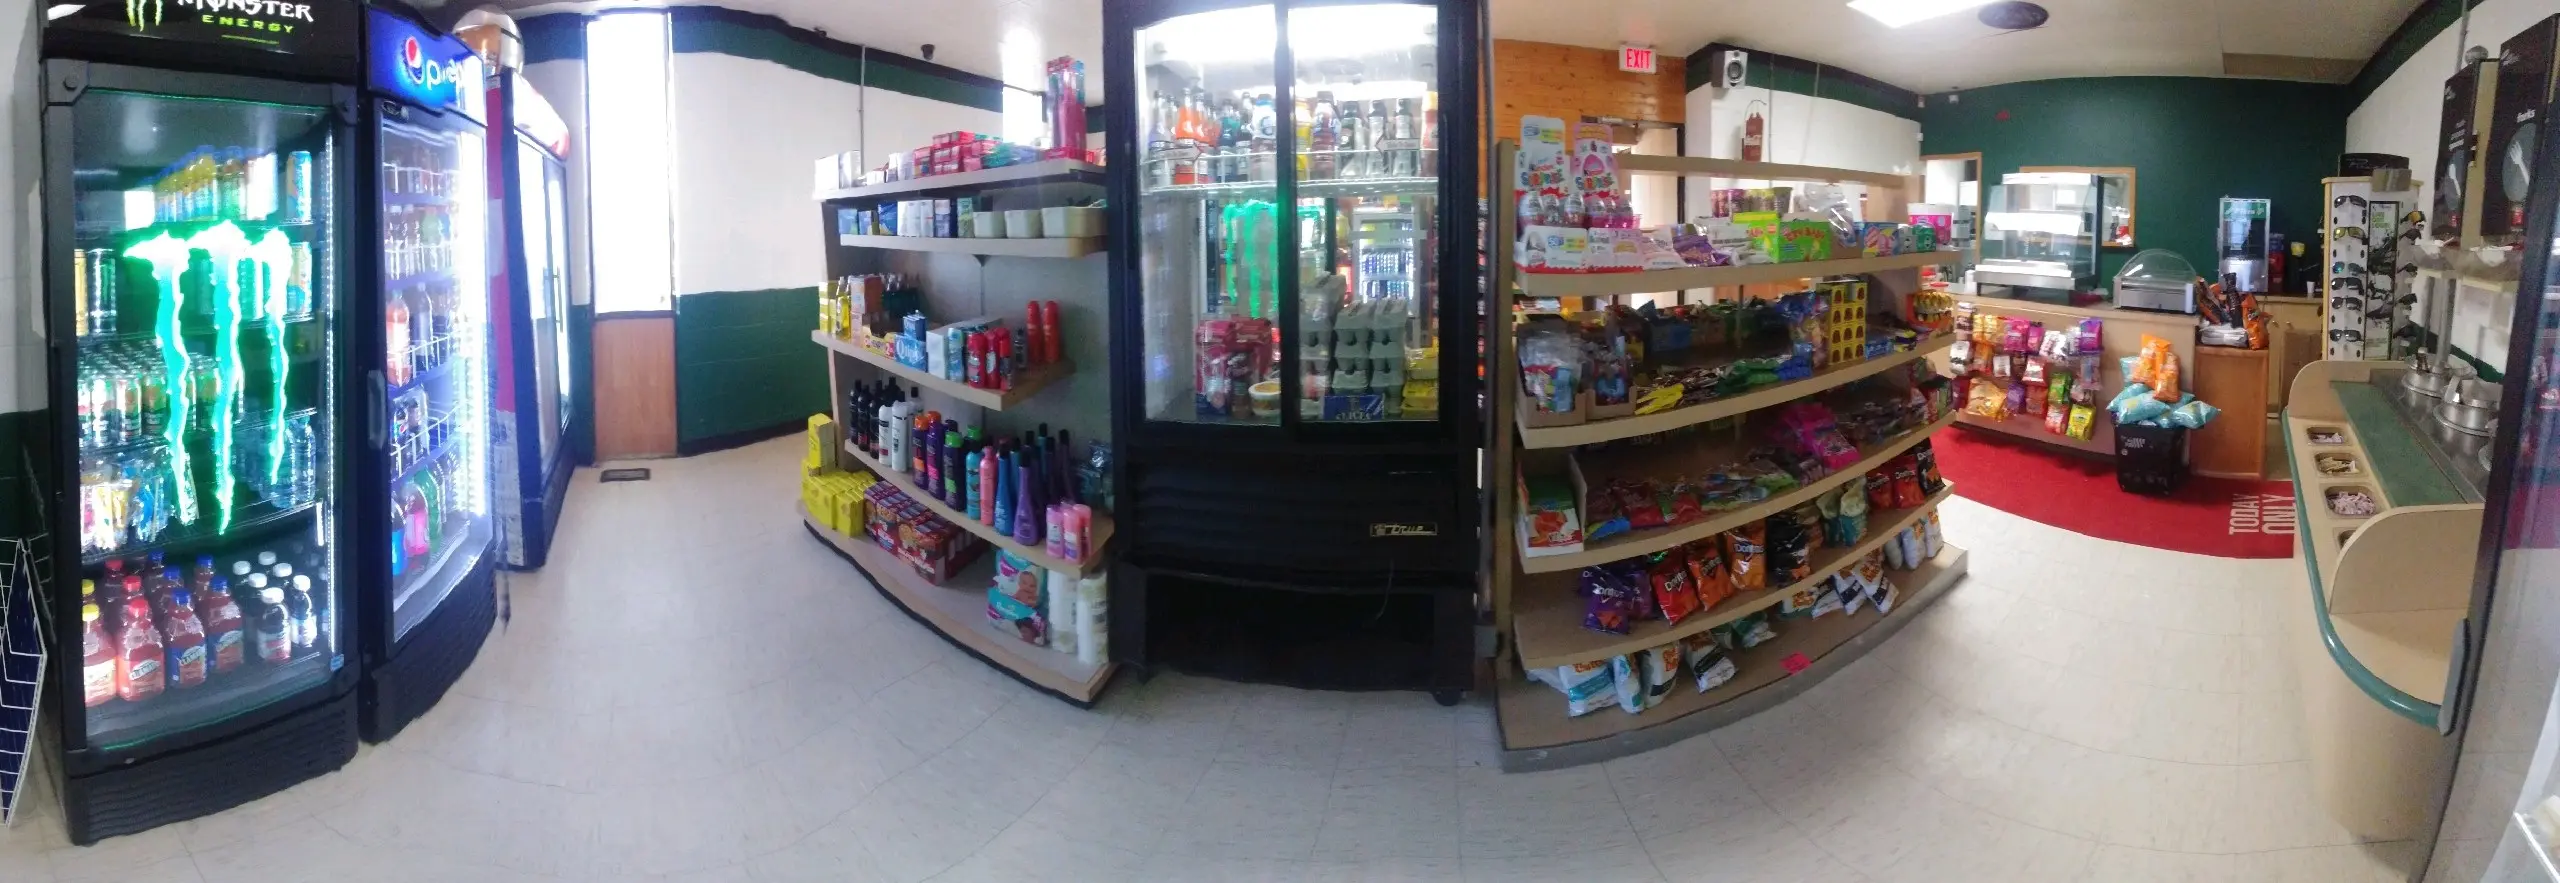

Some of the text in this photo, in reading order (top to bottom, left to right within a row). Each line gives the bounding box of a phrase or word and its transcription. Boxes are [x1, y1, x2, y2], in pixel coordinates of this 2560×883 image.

[201, 14, 294, 33] ENERGY
[1625, 48, 1652, 69] EXIT
[2228, 493, 2260, 535] TODAY
[2261, 493, 2296, 535] ONLY
